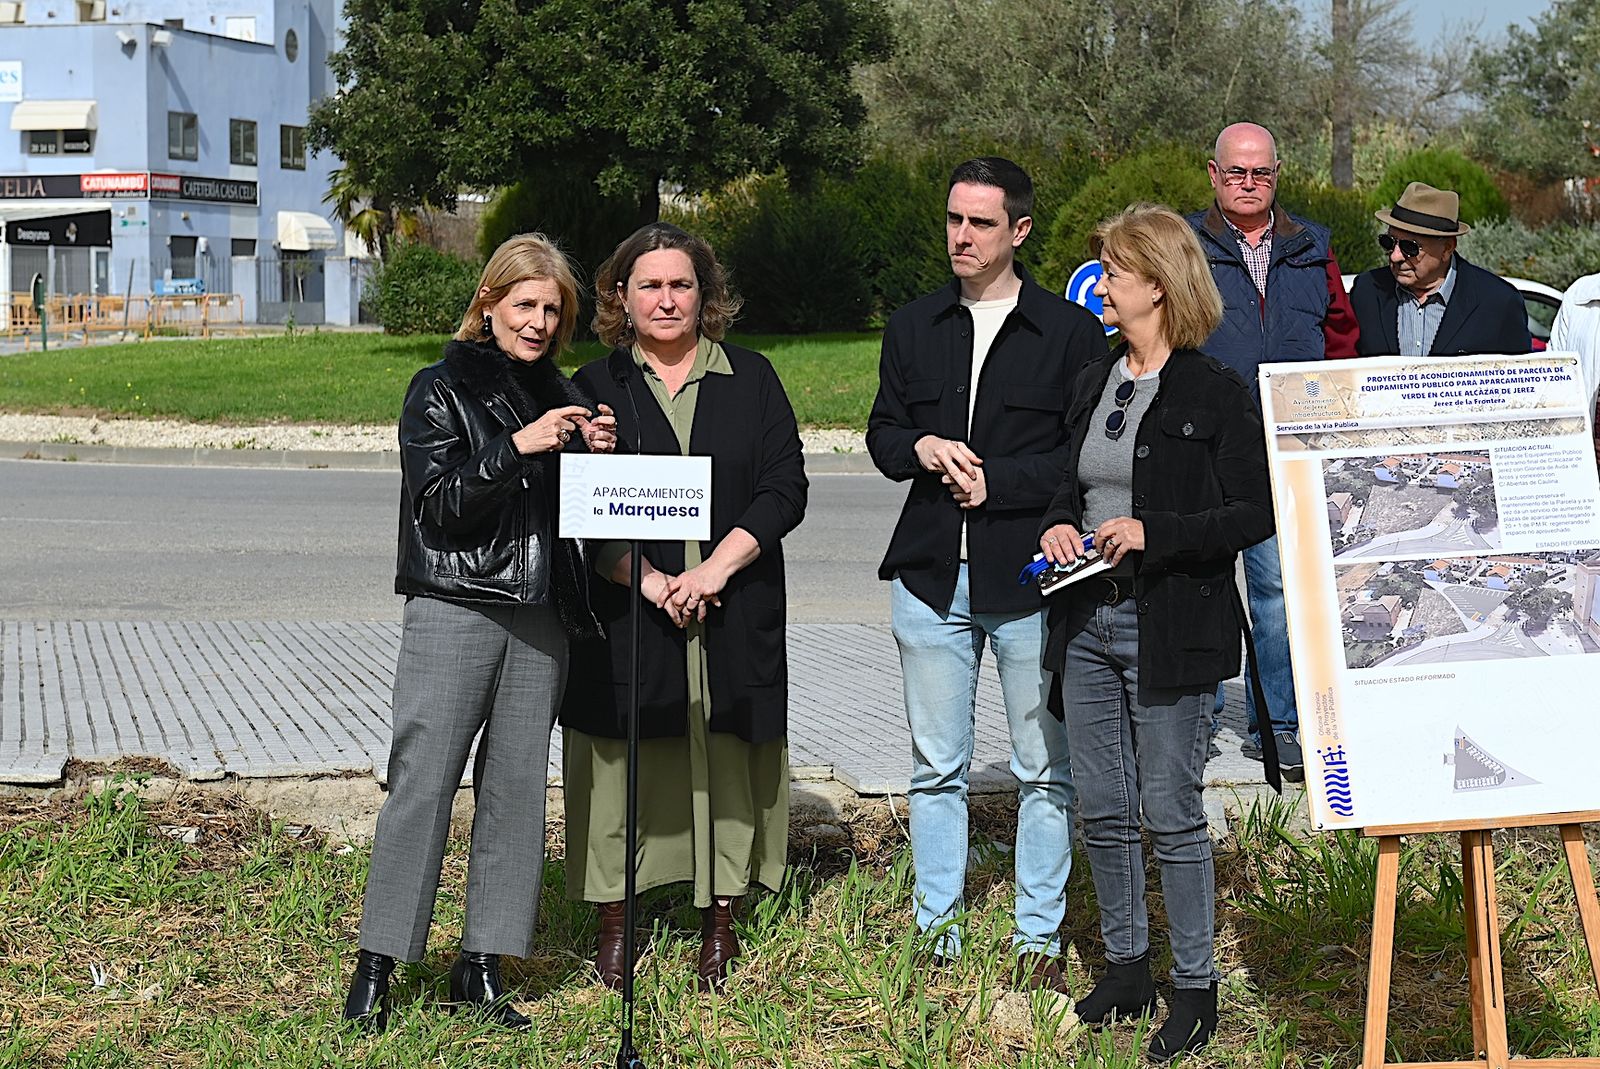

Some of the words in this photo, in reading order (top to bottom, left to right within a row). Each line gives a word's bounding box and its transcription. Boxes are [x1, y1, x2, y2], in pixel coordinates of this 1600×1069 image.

[1361, 383, 1420, 392] EQUIPAMIENTO
[1480, 376, 1541, 385] APARCAMIENTO
[1367, 375, 1407, 383] PROYECTO
[1420, 370, 1505, 380] ACONDICIONAMIENTO
[592, 486, 704, 500] APARCAMIENTOS
[593, 507, 603, 515] la
[609, 502, 699, 520] Marquesa
